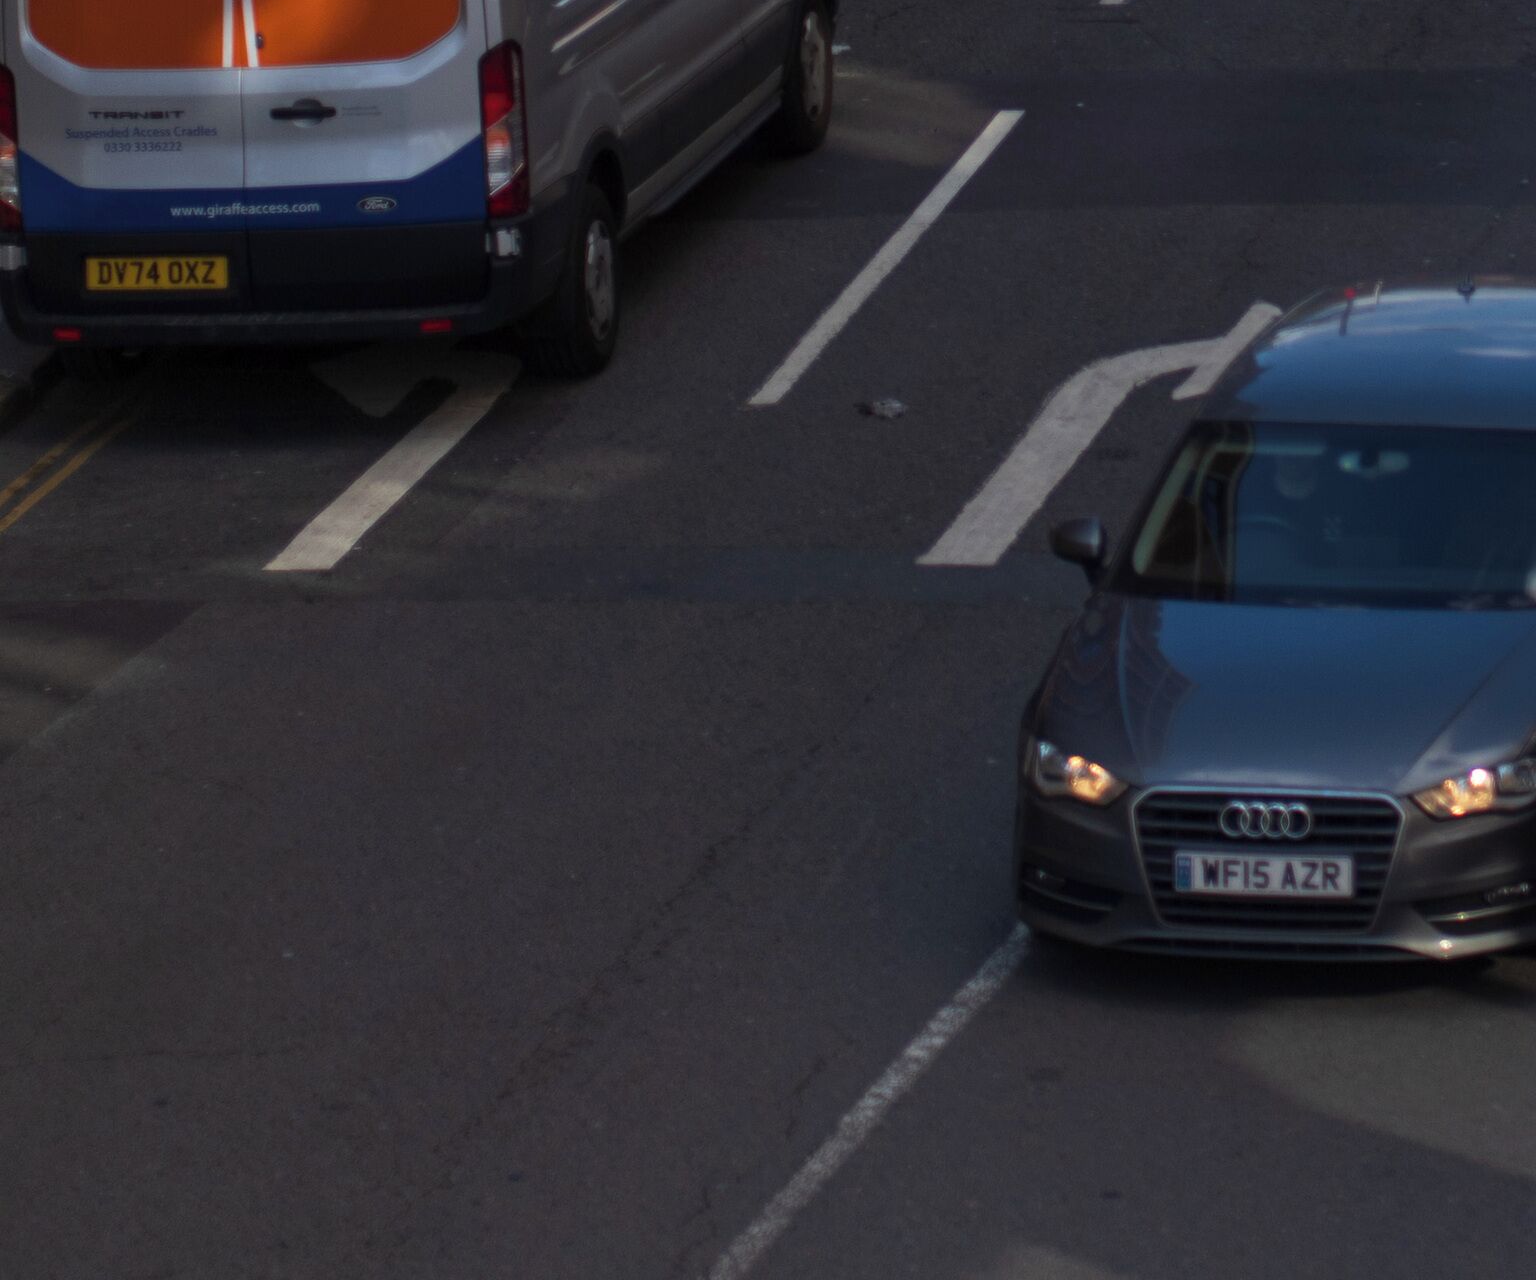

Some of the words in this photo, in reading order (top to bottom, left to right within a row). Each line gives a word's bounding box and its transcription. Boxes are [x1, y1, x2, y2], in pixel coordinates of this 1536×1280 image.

[88, 110, 185, 120] TRANSIT
[65, 127, 129, 140] Suspended
[132, 126, 171, 138] Access
[173, 125, 217, 137] Cradles
[104, 141, 131, 153] 0330
[170, 201, 320, 218] www.giraffeaccess.com
[97, 261, 160, 286] DV74
[168, 260, 216, 285] OXZ
[1201, 859, 1270, 889] WF15
[1281, 862, 1340, 890] AZR
